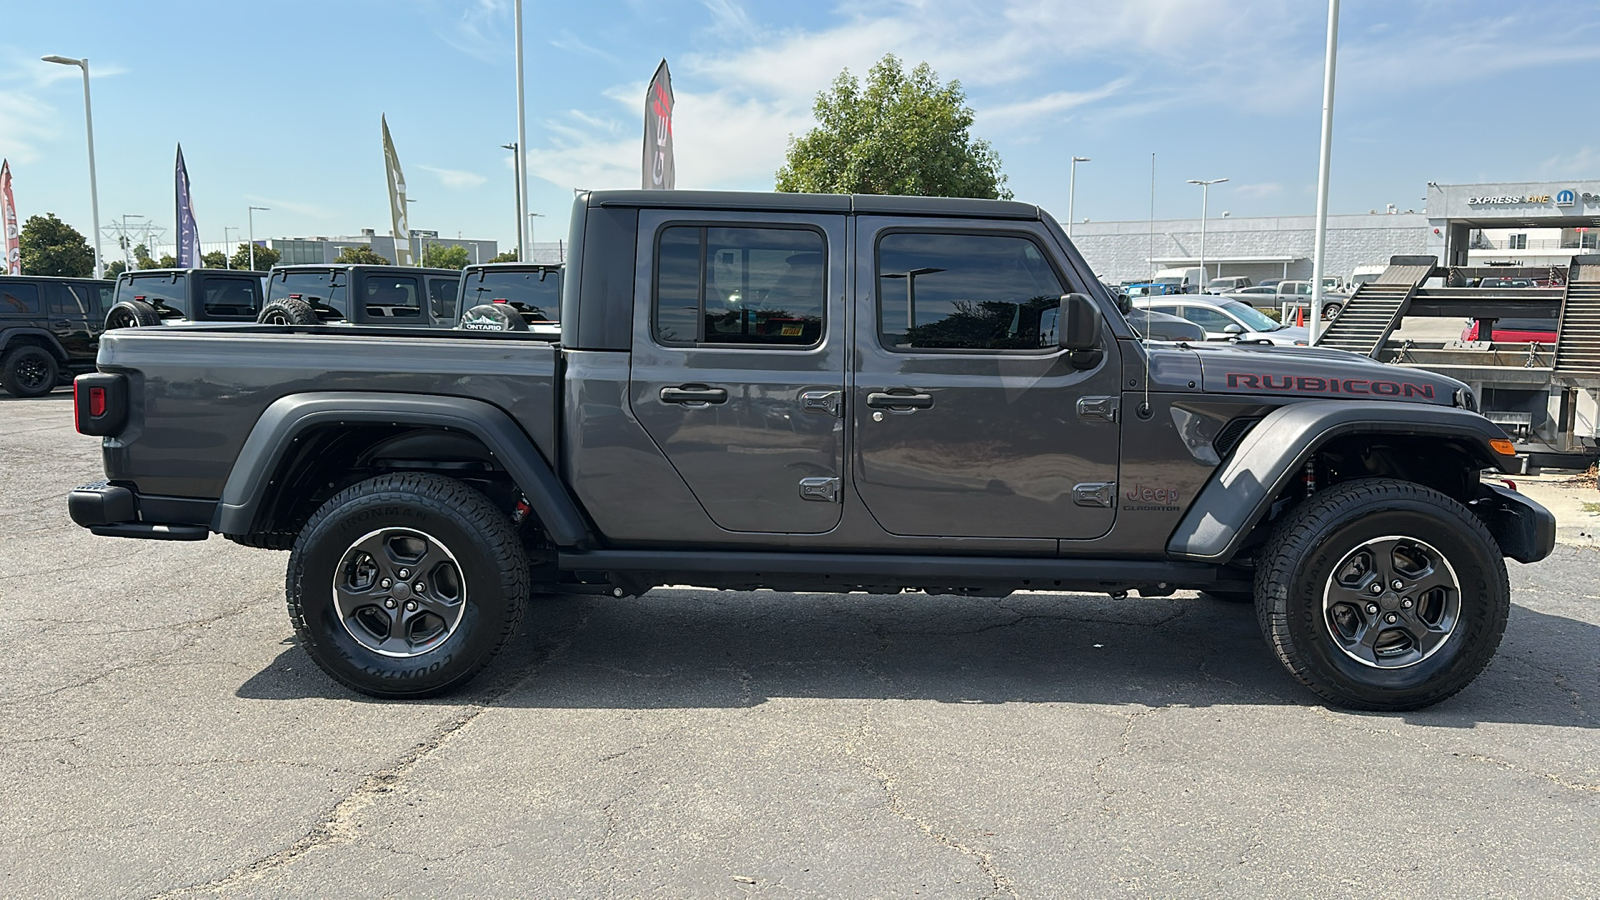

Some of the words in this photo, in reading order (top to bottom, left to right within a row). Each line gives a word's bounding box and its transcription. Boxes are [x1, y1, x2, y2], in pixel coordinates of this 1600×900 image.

[1467, 195, 1520, 204] EXPRESS
[1226, 372, 1435, 399] RUBICON
[1127, 483, 1180, 505] Jeep
[340, 506, 428, 532] IRONMAN
[1303, 553, 1327, 641] IRONMAN
